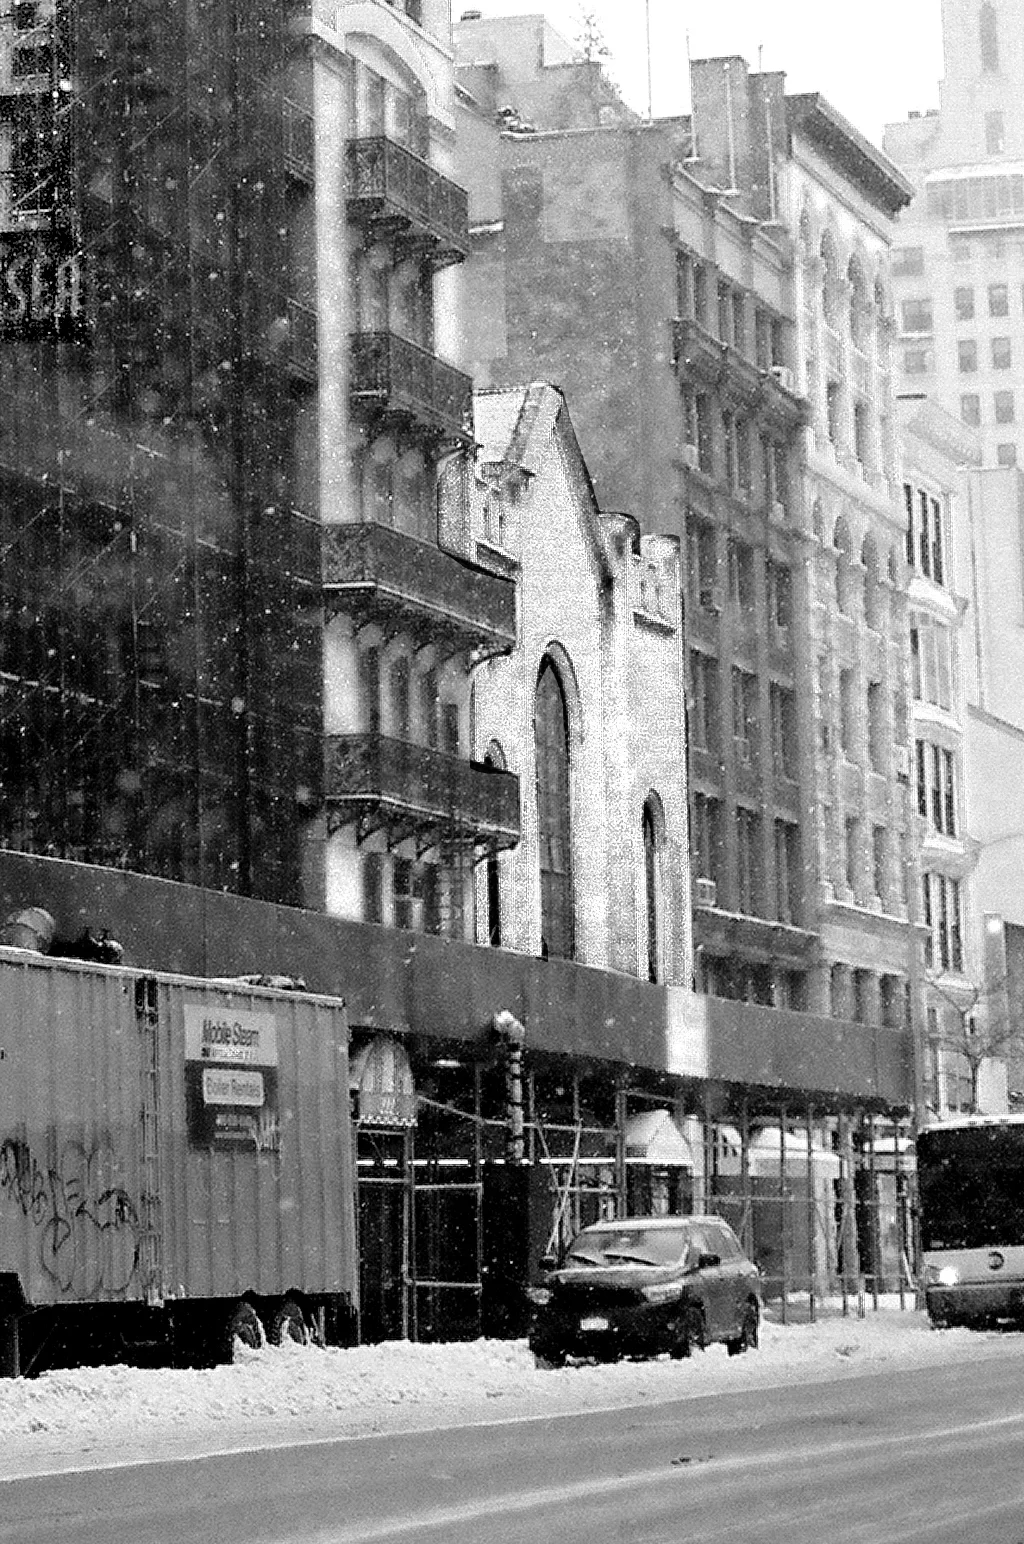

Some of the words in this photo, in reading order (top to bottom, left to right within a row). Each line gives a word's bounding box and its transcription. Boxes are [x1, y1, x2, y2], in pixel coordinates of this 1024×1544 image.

[202, 1019, 231, 1044] Mobile
[233, 1022, 259, 1046] Steam
[206, 1075, 230, 1096] Boiler
[232, 1078, 262, 1098] Rentals
